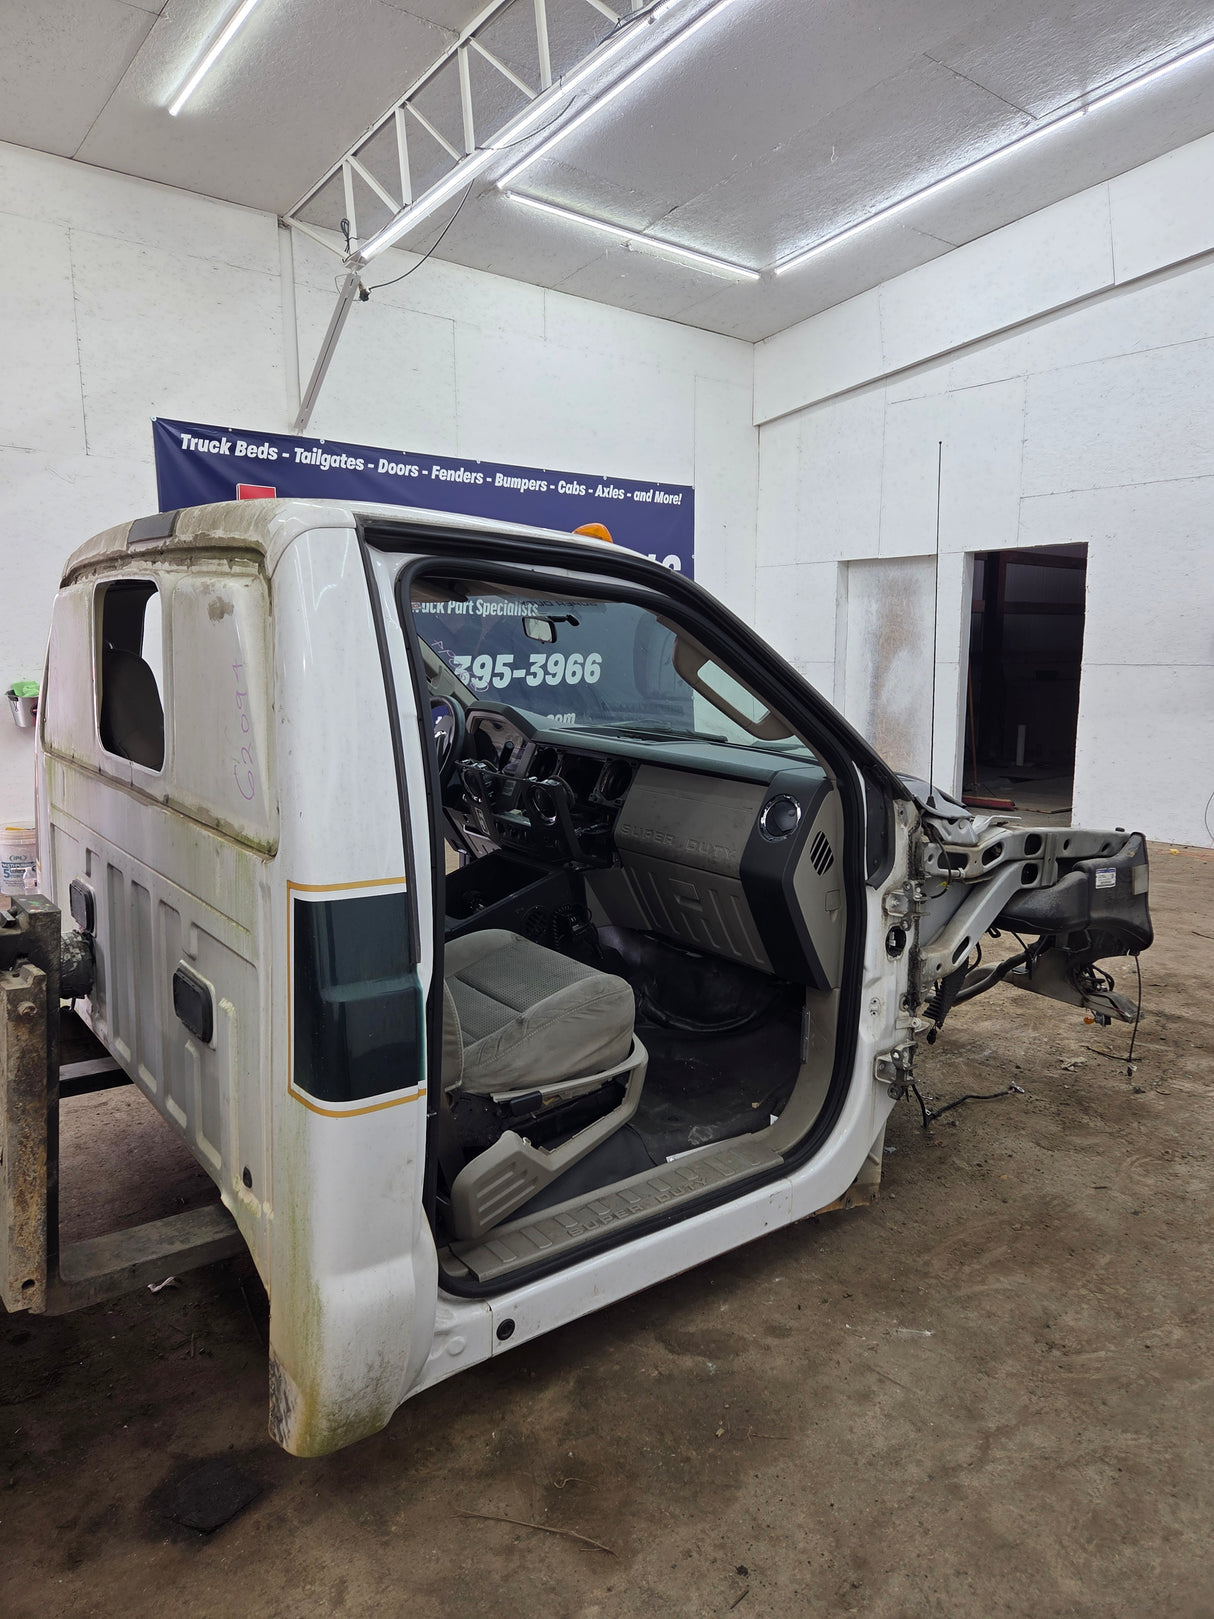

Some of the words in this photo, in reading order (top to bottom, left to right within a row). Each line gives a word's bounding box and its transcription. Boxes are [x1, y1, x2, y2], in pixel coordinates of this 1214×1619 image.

[180, 433, 232, 456] Truck
[234, 440, 278, 461] Beds
[294, 447, 365, 471] Tailgates
[377, 458, 419, 478] Doors
[431, 465, 484, 485] Fenders
[494, 472, 548, 493] Bumpers
[557, 480, 587, 496] Cabs
[595, 484, 625, 500] Axles
[633, 488, 653, 503] and
[653, 490, 683, 506] More!
[446, 600, 474, 615] Part
[475, 599, 539, 617] Specialists
[453, 652, 602, 689] 395-3966
[620, 823, 676, 846] SUPER
[686, 838, 738, 860] DUTY
[567, 1204, 644, 1238] SUPER
[655, 1177, 709, 1205] DUTY
